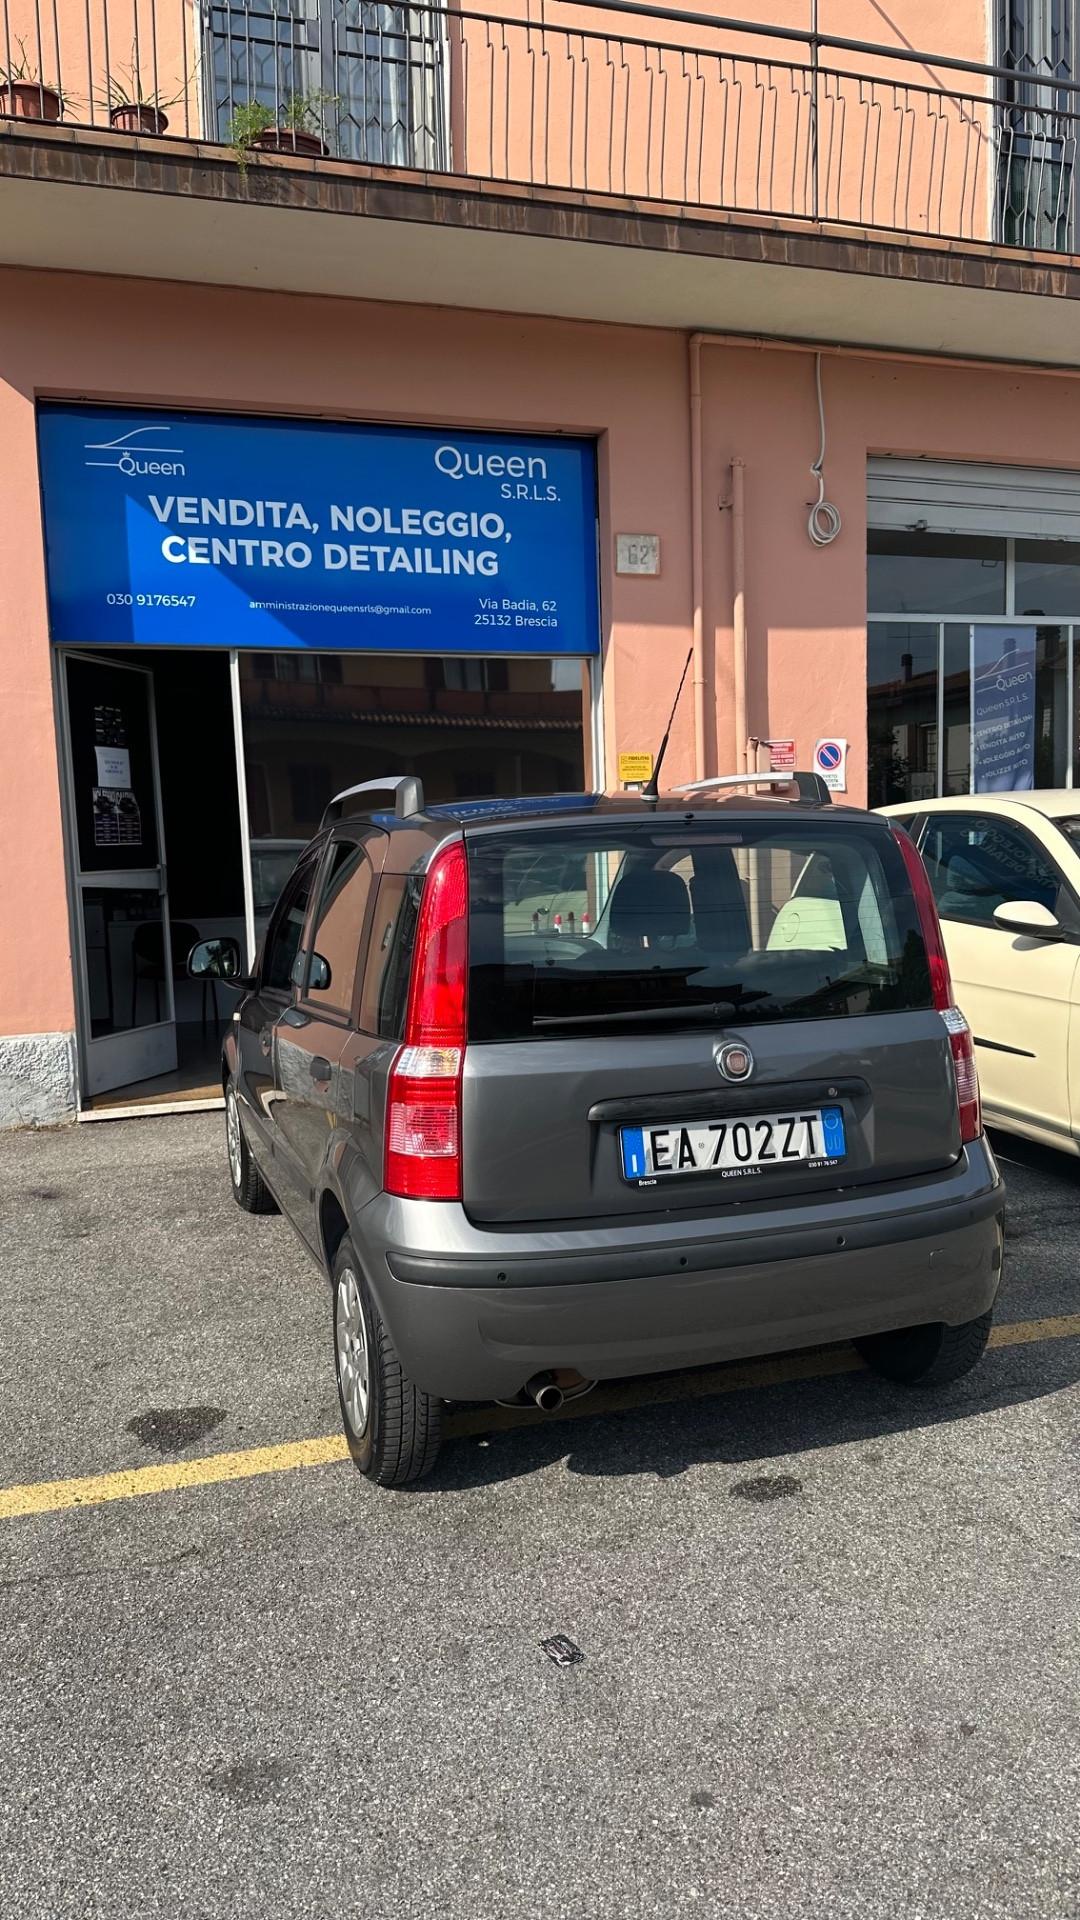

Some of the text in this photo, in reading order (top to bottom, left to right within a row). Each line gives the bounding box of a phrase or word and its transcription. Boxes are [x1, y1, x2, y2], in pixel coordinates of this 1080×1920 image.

[118, 454, 185, 477] Queen
[434, 446, 547, 480] Queen
[500, 483, 561, 502] S.R.L.S.
[148, 494, 512, 544] VENDITA, NOLEGGIO,
[160, 535, 499, 577] CENTRO DETAILING
[106, 593, 196, 608] 030 9176547
[249, 601, 432, 616] amministrazionequeensrls@gmail.com
[478, 597, 557, 613] Via Badia, 62
[473, 614, 558, 628] 25132 Brescia
[995, 671, 1033, 692] Queen
[650, 1128, 697, 1171] EA
[708, 1115, 818, 1165] 702ZT
[721, 1168, 742, 1178] QUEEN
